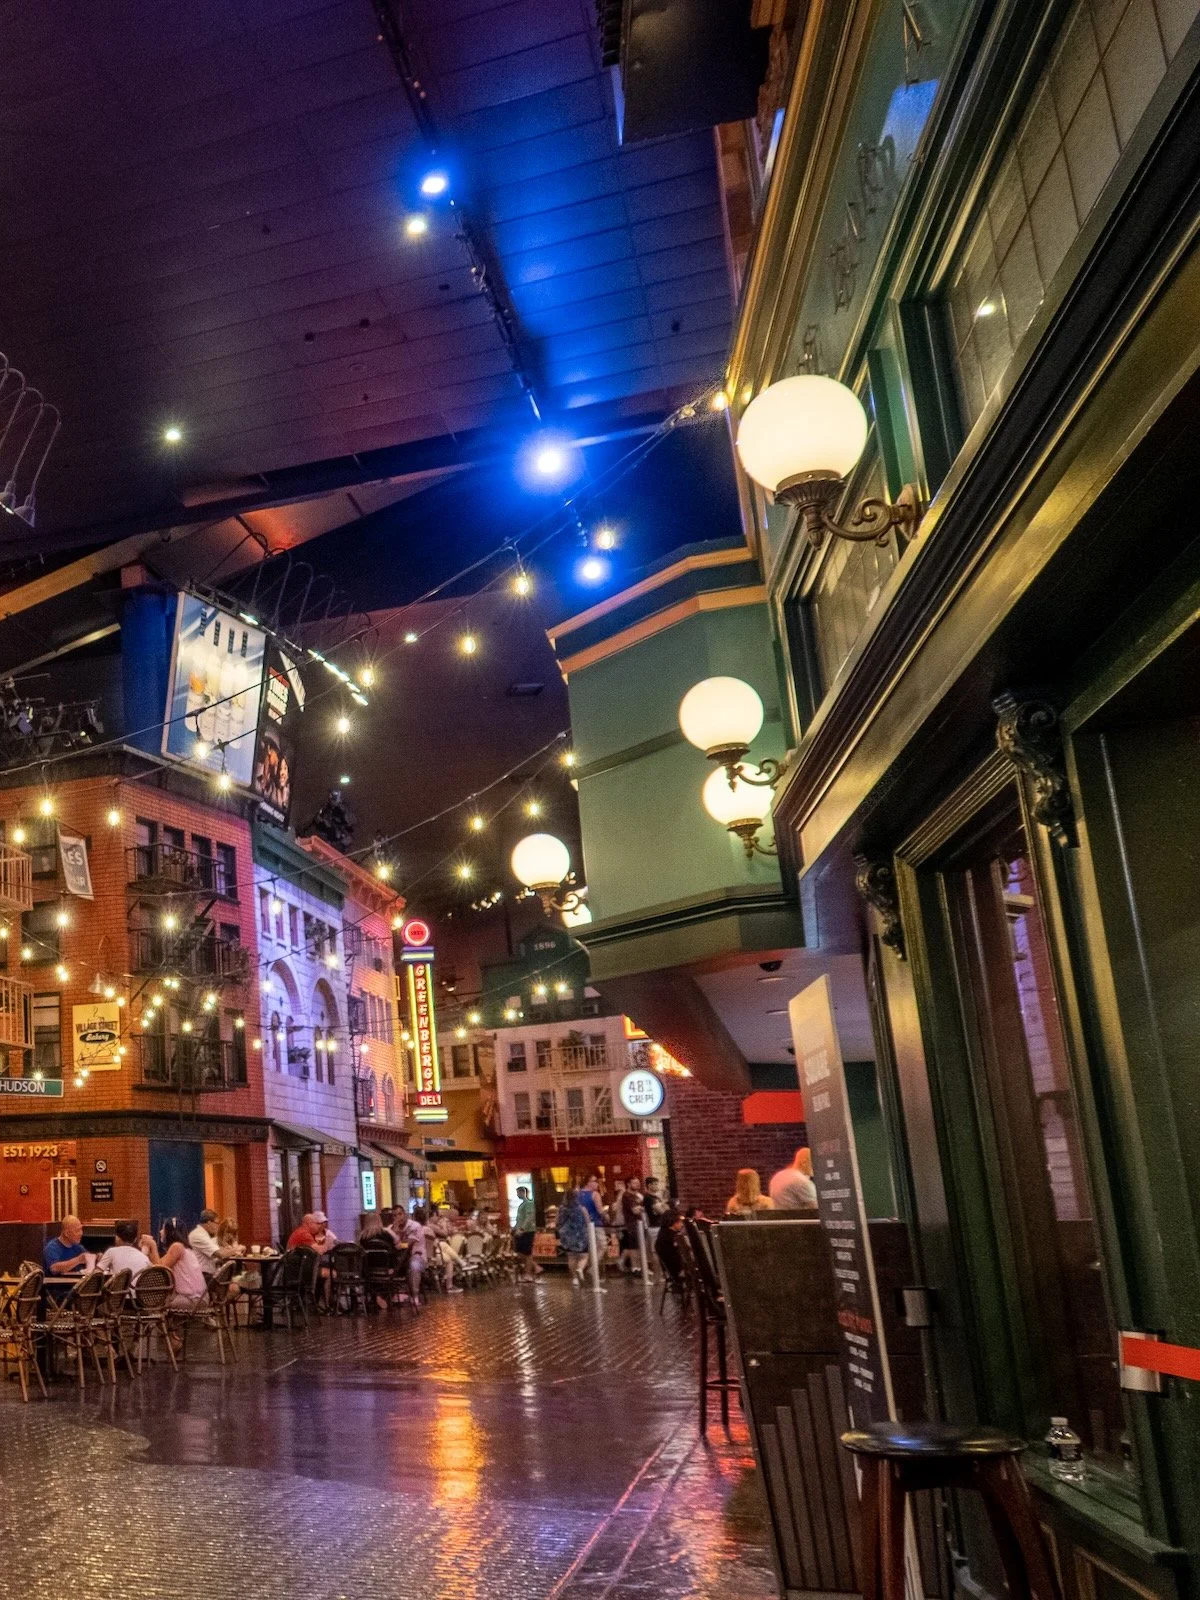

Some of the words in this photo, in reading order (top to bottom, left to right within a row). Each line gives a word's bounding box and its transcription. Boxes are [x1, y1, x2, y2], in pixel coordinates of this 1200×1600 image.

[420, 1094, 442, 1106] DELI
[2, 1145, 27, 1157] EST.
[29, 1144, 58, 1158] 1923
